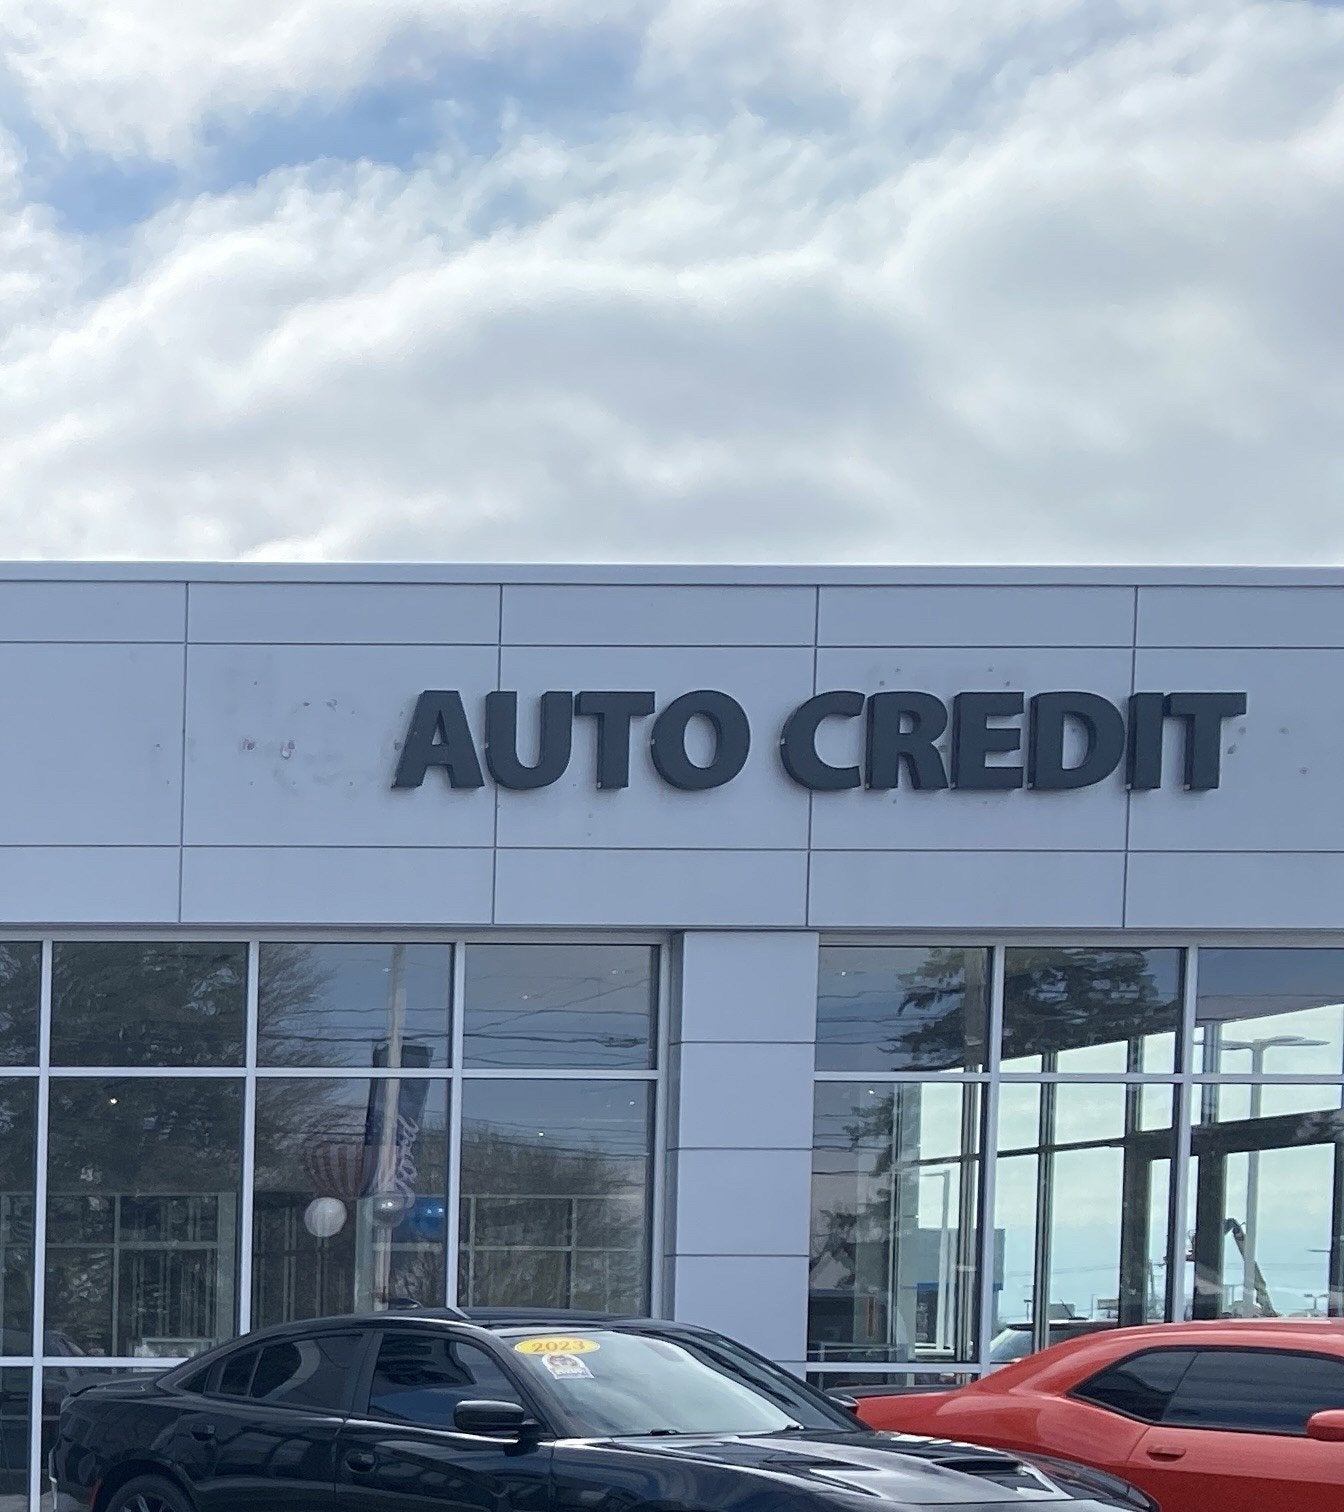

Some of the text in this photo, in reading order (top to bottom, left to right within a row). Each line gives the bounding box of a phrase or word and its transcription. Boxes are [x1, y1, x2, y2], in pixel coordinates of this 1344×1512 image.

[390, 690, 1248, 791] AUTO CREDIT
[531, 1340, 585, 1353] 2023
